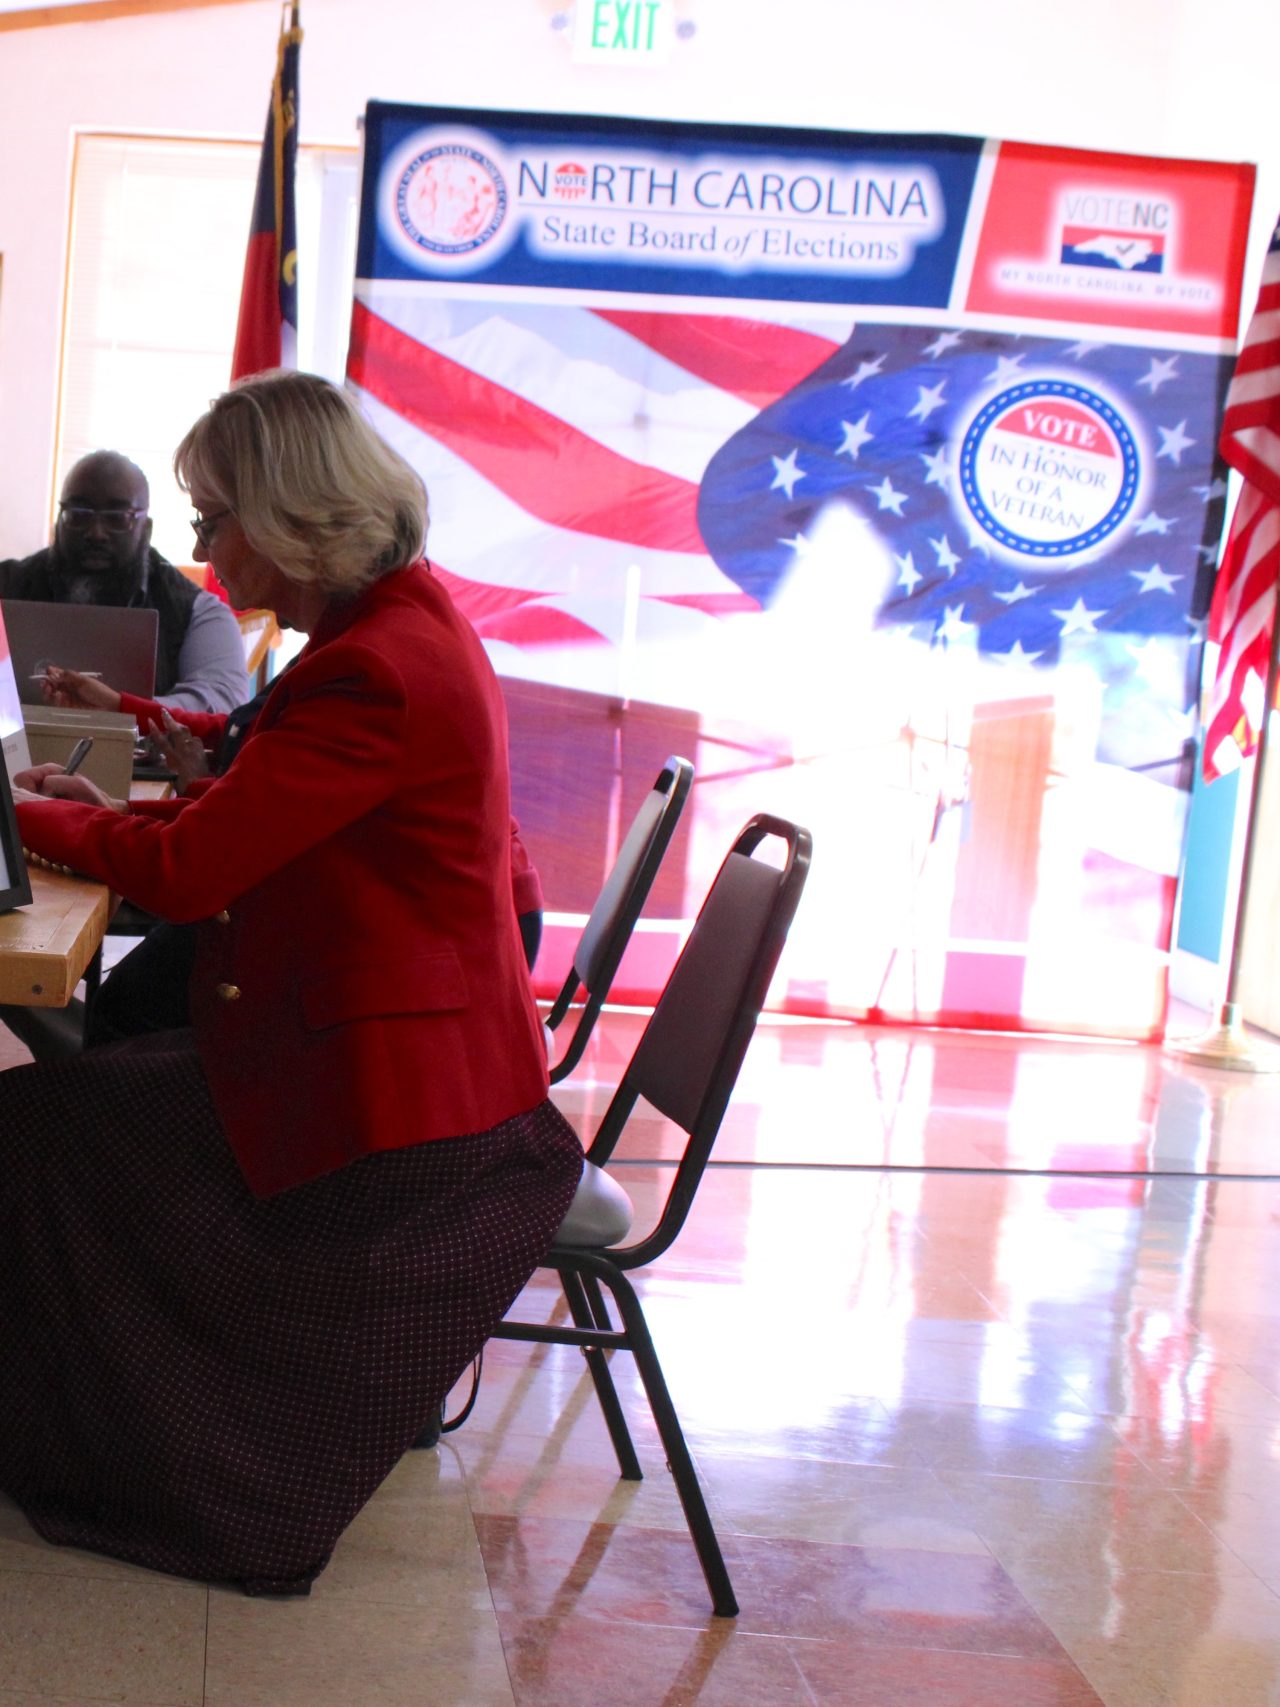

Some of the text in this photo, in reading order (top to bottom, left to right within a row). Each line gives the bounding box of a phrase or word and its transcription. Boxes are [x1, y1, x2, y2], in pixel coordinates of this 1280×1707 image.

[592, 0, 660, 50] EXIT
[554, 175, 588, 187] VOTE
[693, 171, 928, 217] CAROLINA
[542, 216, 899, 260] State Board of Elections
[1026, 271, 1071, 286] NORTH
[1022, 408, 1099, 448] VOTE
[990, 444, 1108, 489] IN HONOR
[1016, 475, 1063, 502] OF A
[991, 490, 1084, 530] VETERAN
